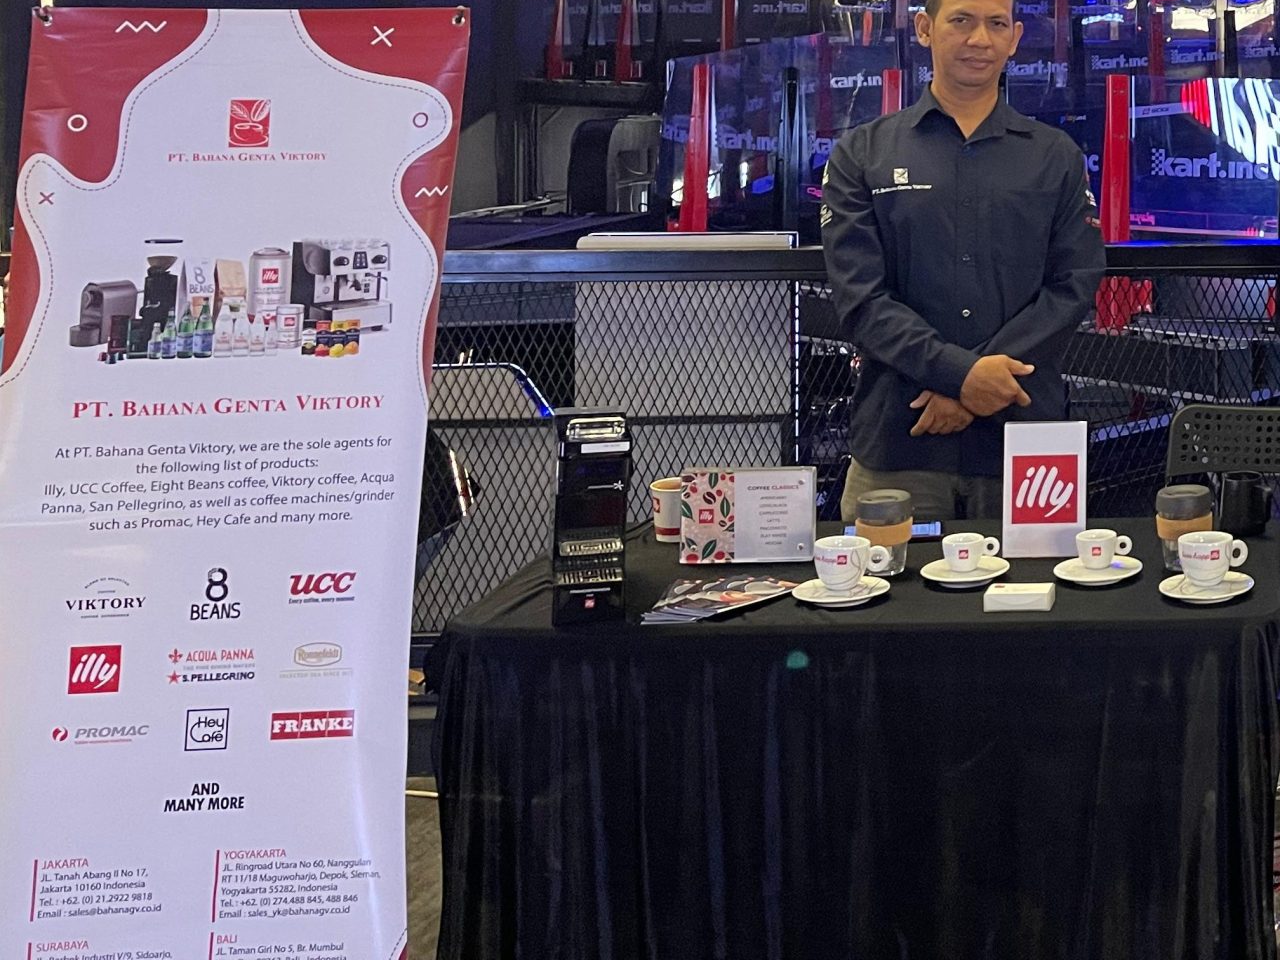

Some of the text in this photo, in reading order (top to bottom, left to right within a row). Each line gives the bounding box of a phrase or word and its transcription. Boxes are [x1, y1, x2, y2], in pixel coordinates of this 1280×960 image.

[1006, 59, 1068, 76] kart.inc
[1091, 54, 1149, 70] kart.inc
[167, 153, 188, 162] PT.
[1151, 148, 1270, 180] kart.inc
[189, 283, 214, 295] BEANS
[72, 395, 385, 419] PT. BAHANA GENTA VIKTORY
[55, 435, 392, 459] At PT. Bahana Genta Viktory, we are the sole agents for
[136, 457, 319, 474] the following list of products:
[70, 483, 98, 495] UCC
[102, 481, 147, 494] Coffee,
[151, 480, 184, 494] Eight
[188, 479, 225, 491] Beans
[228, 477, 269, 489] coffee,
[271, 475, 315, 488] Viktory
[317, 473, 358, 485] coffee,
[360, 472, 395, 485] Acqua
[1015, 464, 1074, 518] illy
[41, 490, 395, 514] Panna, San Pellegrino, as well as coffee machines/grinder
[89, 511, 353, 531] such as Promac, Hey Cafe and many more.
[205, 567, 229, 602] 8
[66, 597, 146, 610] VIKTORY
[190, 602, 241, 621] BEANS
[186, 648, 255, 662] ACQUA PANNA
[71, 653, 118, 689] illy
[191, 671, 255, 683] PELLEGRINO
[198, 716, 225, 730] Hey
[273, 716, 353, 734] FRANKE
[74, 724, 150, 739] PROMAC
[191, 783, 220, 796] AND
[164, 796, 245, 812] MANY MORE
[224, 848, 287, 860] YOGYAKARTA
[42, 858, 89, 870] JAKARTA
[54, 870, 111, 882] Tanah Abang
[40, 881, 146, 894] Jakarta 10160 Indonesia
[220, 886, 267, 897] Yogyakarta
[298, 883, 338, 892] Indonesia
[36, 940, 89, 952] SURABAYA
[216, 935, 237, 945] BALI
